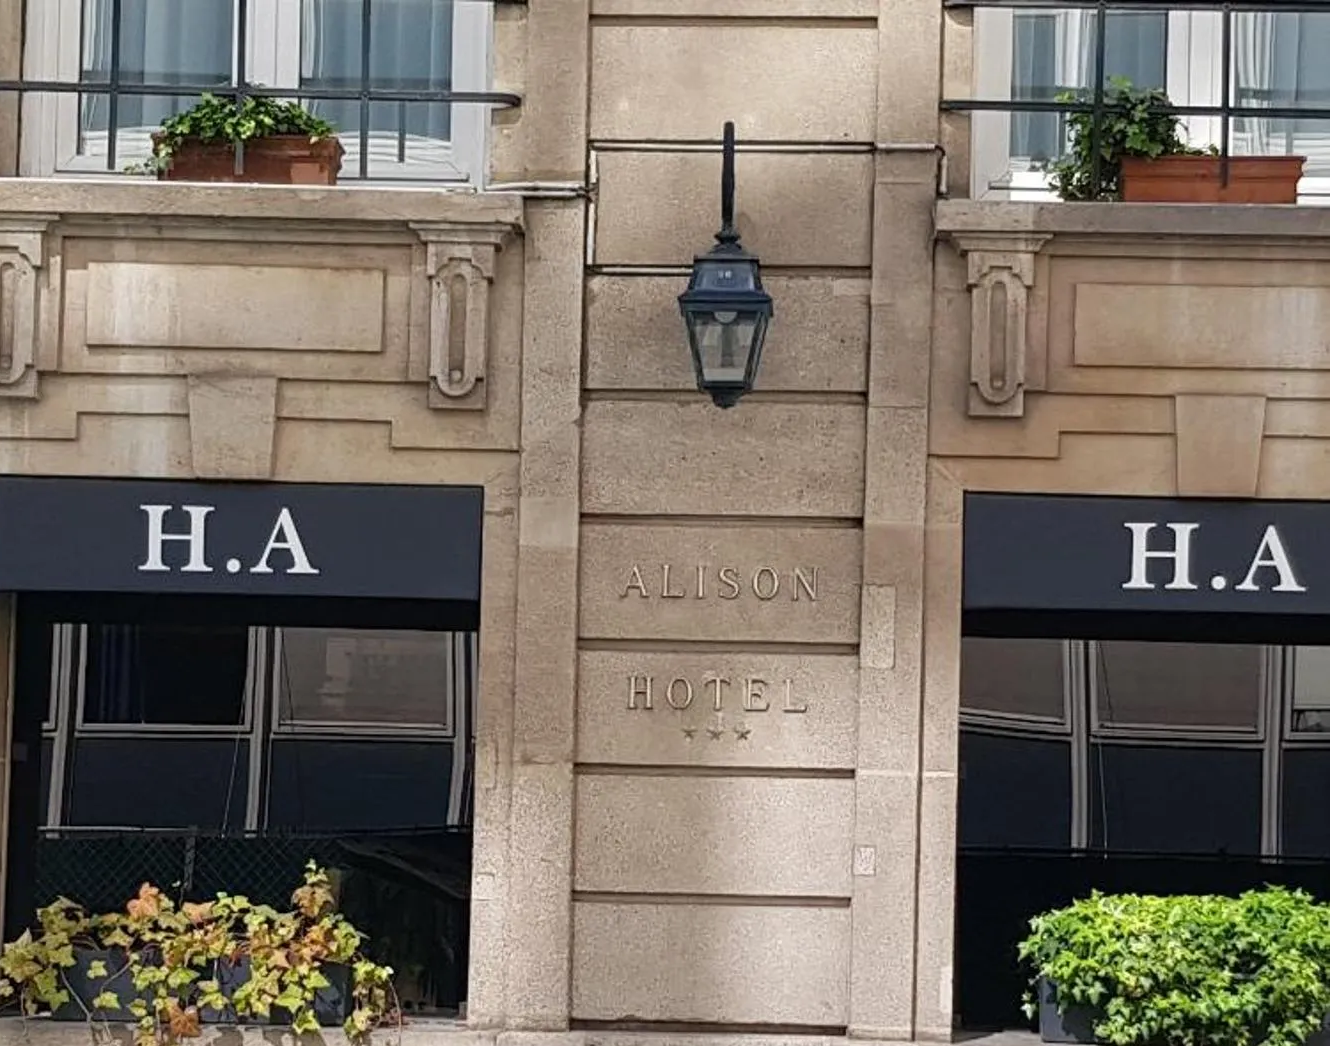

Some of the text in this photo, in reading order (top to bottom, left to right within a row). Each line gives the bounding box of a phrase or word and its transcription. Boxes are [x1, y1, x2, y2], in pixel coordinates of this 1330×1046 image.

[137, 504, 320, 574] H.A
[1121, 521, 1307, 592] H.A
[621, 564, 820, 601] ALISON
[626, 675, 808, 713] HOTEL
